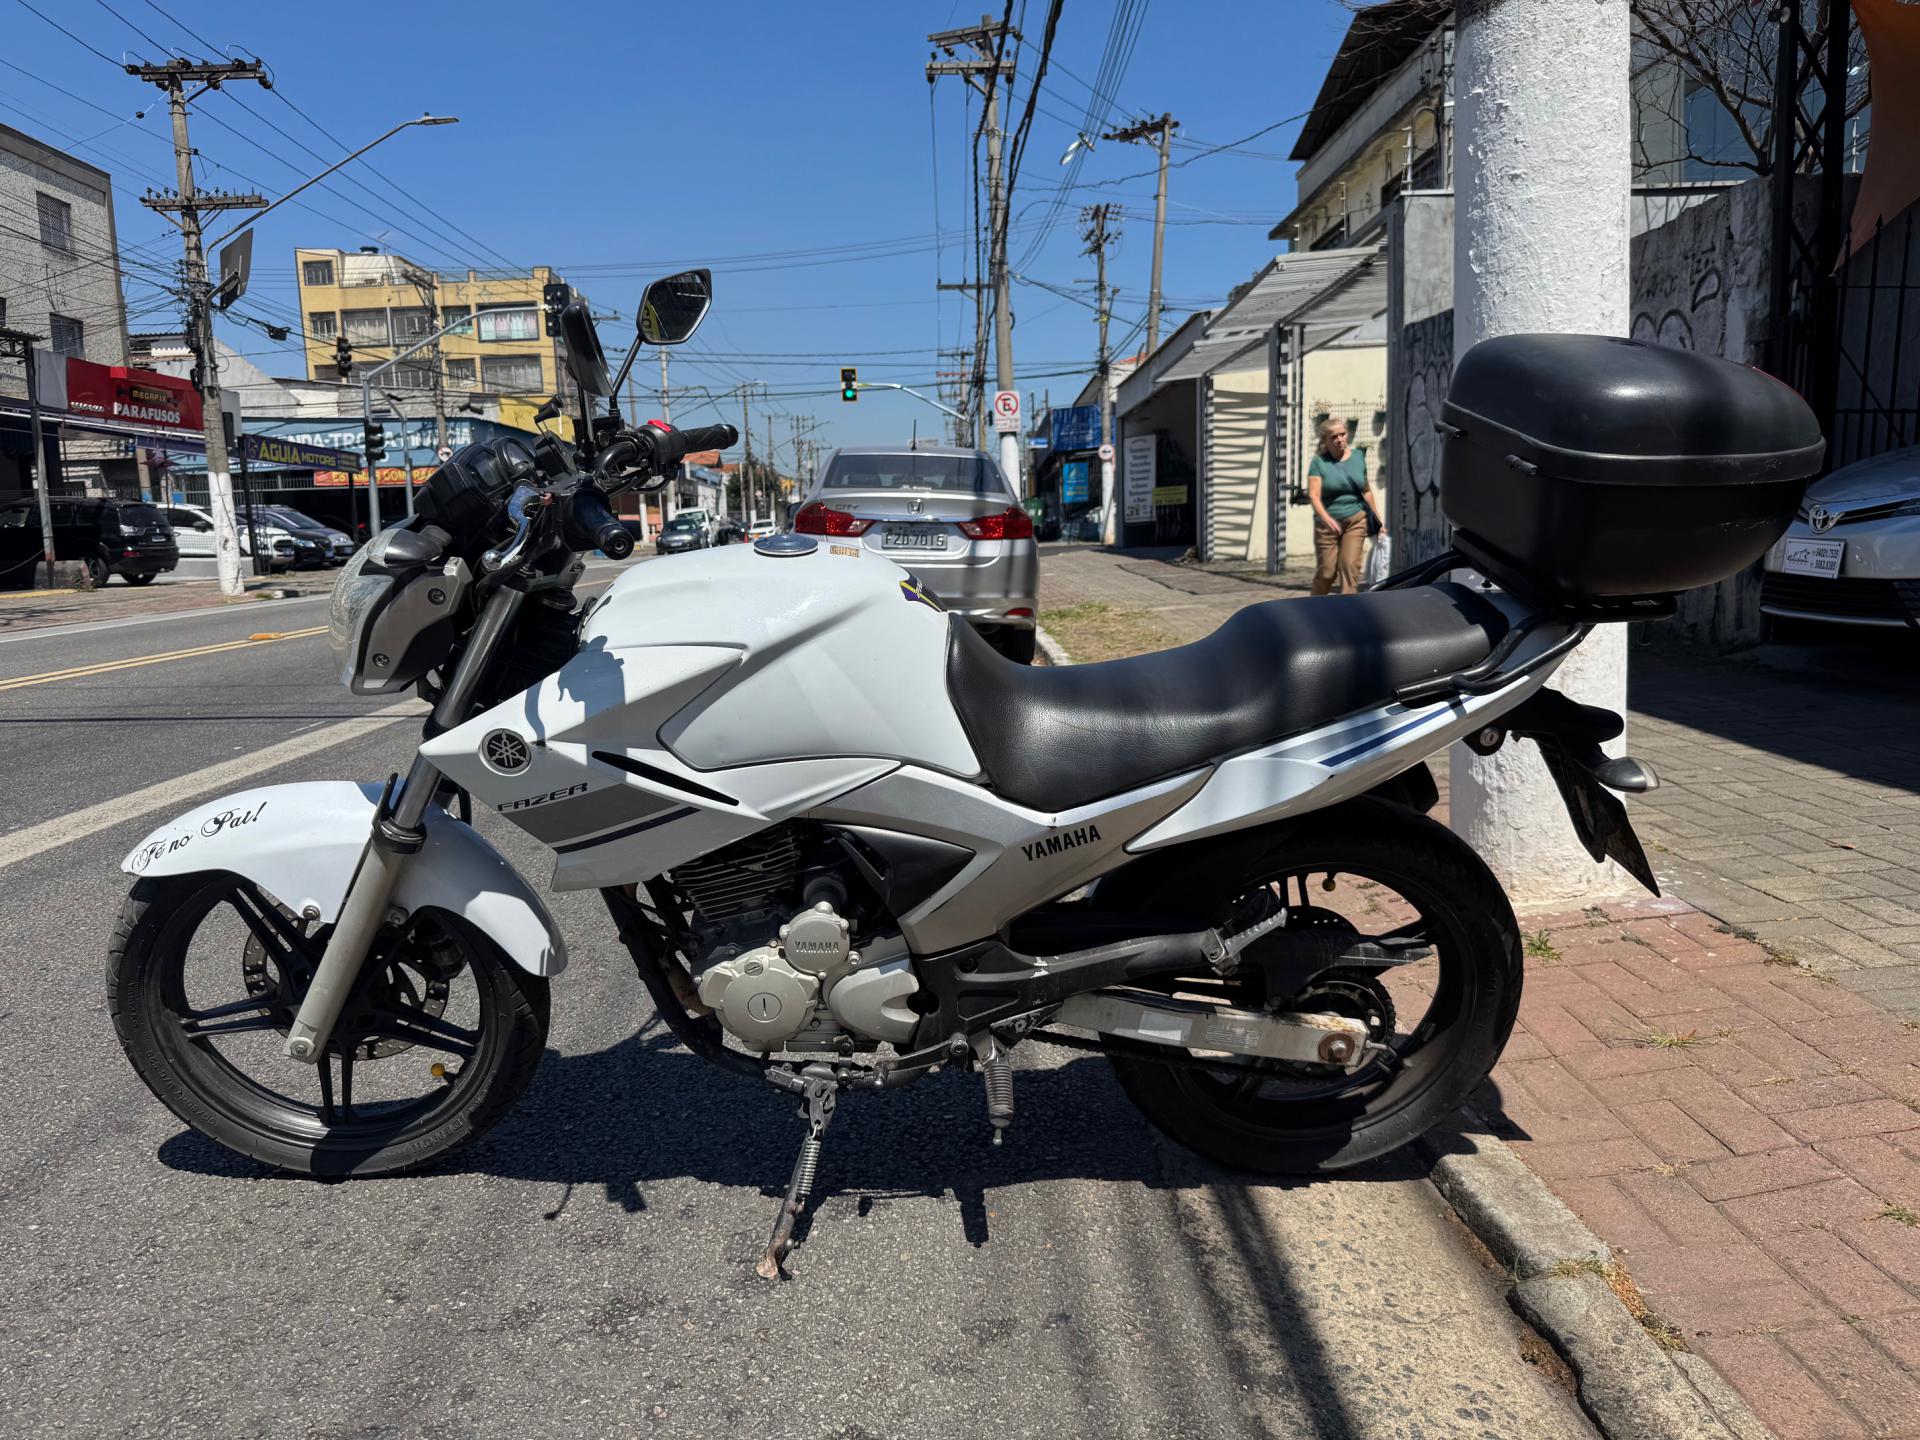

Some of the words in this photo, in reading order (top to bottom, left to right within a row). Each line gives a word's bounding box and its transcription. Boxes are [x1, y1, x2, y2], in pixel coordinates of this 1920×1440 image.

[114, 402, 181, 424] PARAFUSOS
[301, 452, 336, 466] MOTORS
[498, 782, 588, 811] FAZER
[168, 835, 193, 853] no
[1021, 824, 1102, 862] YAMAHA
[795, 941, 839, 953] YAMAHA
